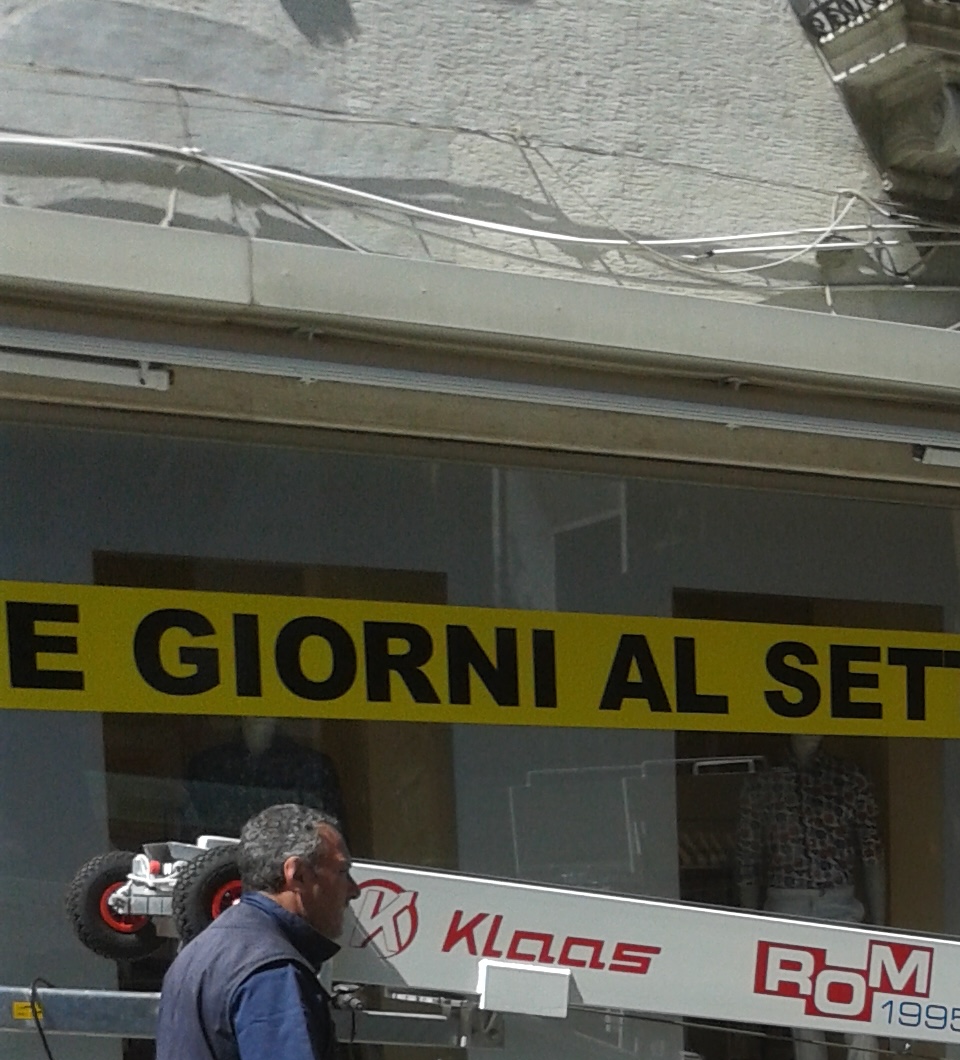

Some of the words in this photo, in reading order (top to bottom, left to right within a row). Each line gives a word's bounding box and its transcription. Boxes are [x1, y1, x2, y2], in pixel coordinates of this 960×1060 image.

[5, 601, 85, 691] E
[133, 608, 558, 708] GIORNI
[599, 633, 729, 714] AL
